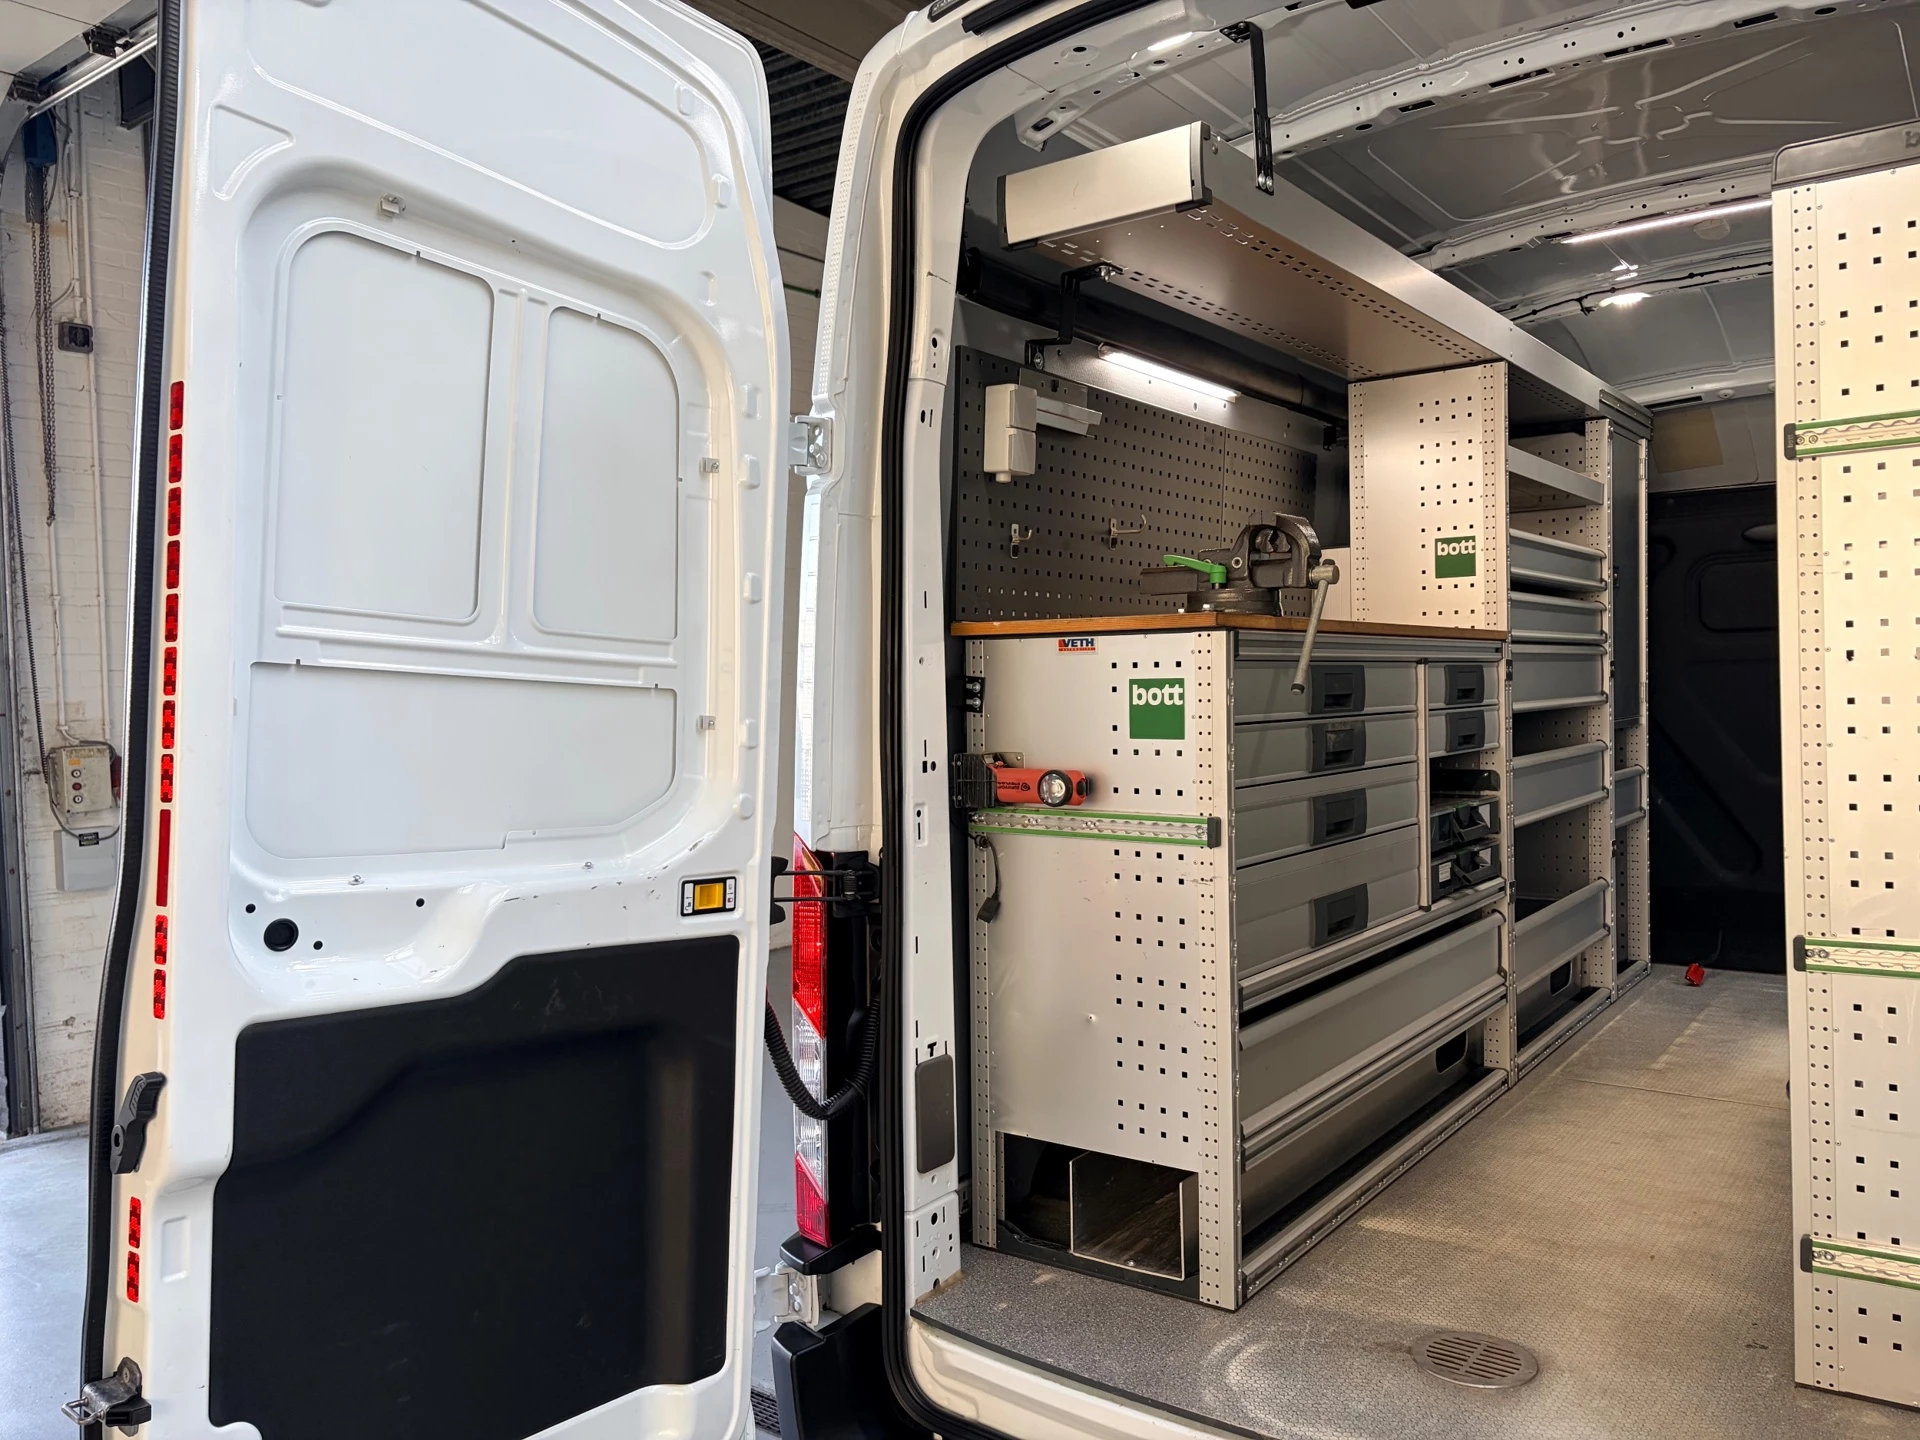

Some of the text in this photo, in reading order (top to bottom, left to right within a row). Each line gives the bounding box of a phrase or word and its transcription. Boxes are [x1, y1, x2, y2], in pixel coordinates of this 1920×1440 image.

[1437, 539, 1475, 555] bott
[1063, 638, 1094, 647] VETH
[1132, 684, 1184, 706] bott
